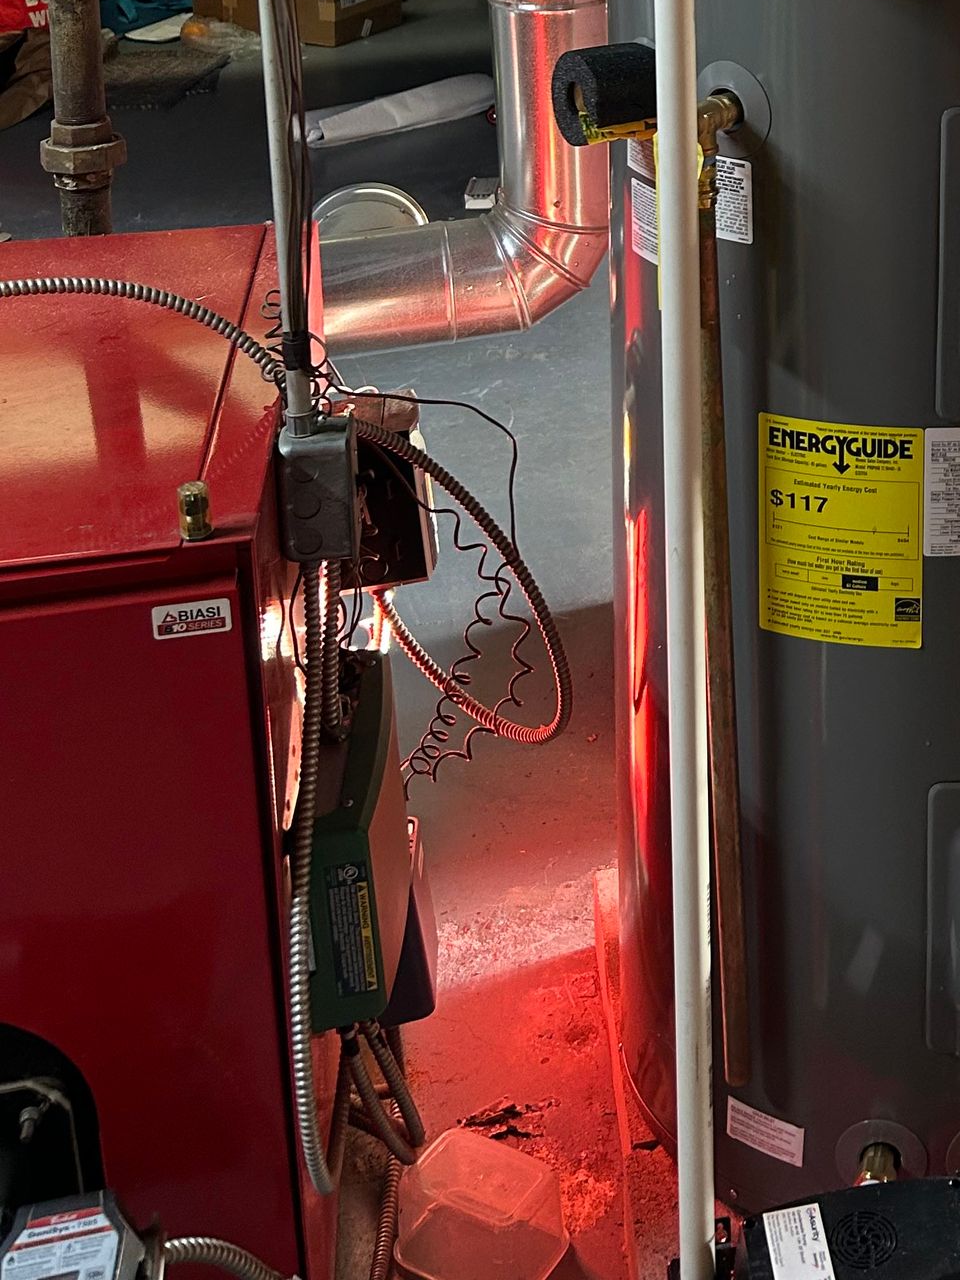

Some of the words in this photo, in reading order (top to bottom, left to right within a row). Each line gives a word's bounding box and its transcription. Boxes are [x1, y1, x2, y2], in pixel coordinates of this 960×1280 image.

[769, 426, 913, 459] ENERGYGUIDE
[793, 479, 821, 489] Estimated
[823, 482, 840, 492] Yearly
[842, 484, 862, 493] Energy
[770, 489, 828, 513] $117
[817, 556, 829, 564] First
[831, 557, 845, 566] Hour
[847, 560, 865, 568] Rating
[178, 606, 221, 622] BIASI
[164, 623, 187, 633] B10
[187, 619, 223, 630] SERIES
[360, 894, 370, 929] WARNING
[809, 1215, 820, 1241] Asurity
